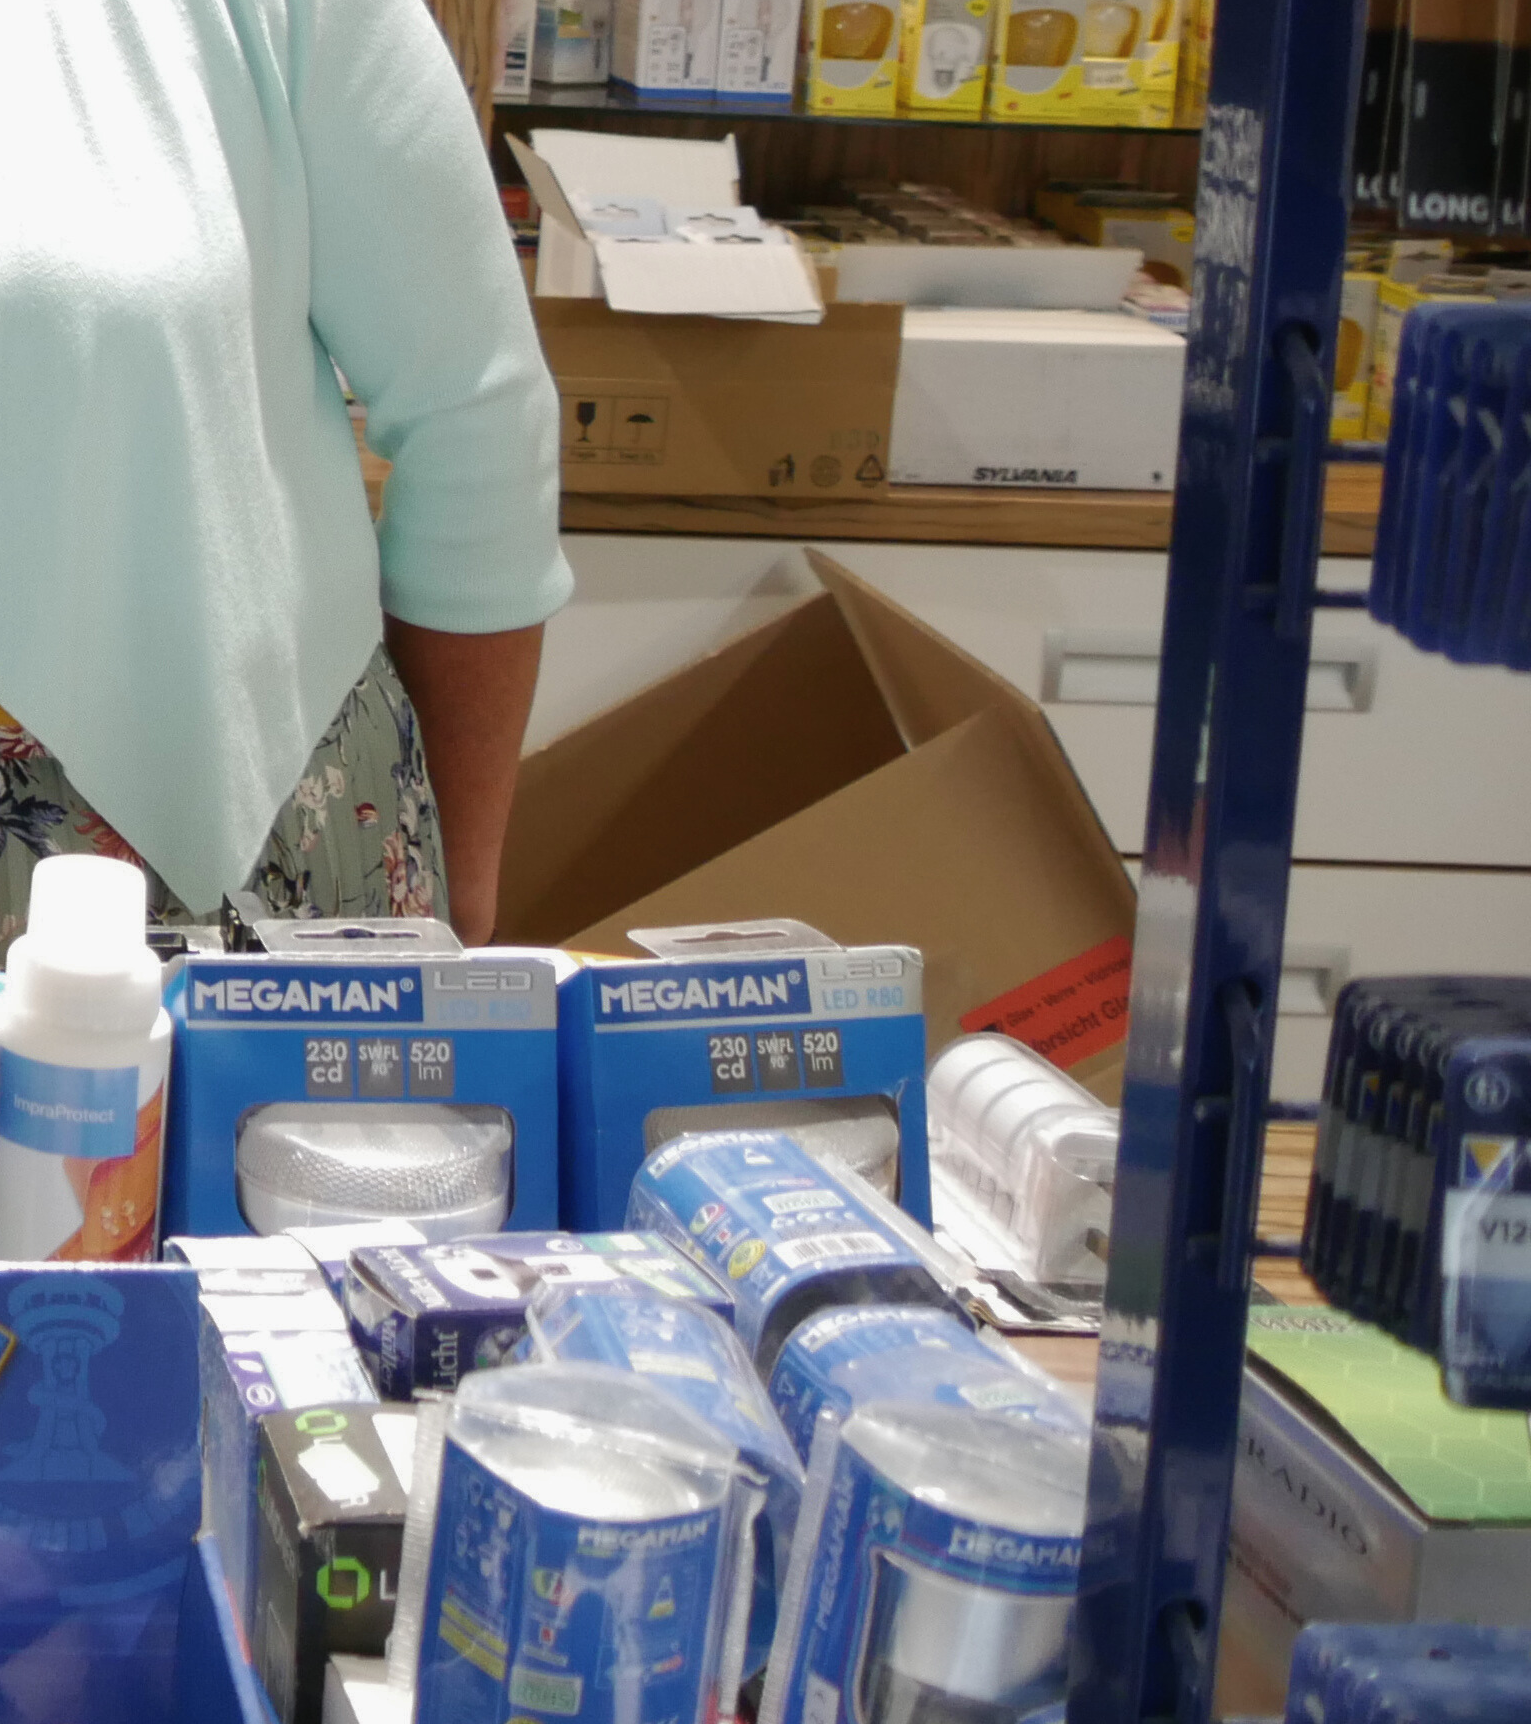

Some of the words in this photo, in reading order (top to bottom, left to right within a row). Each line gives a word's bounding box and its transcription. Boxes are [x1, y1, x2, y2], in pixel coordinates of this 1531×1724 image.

[1409, 194, 1489, 222] LONG
[975, 467, 1077, 483] SYLVANIA
[434, 971, 532, 991] LED
[821, 958, 905, 980] LED
[823, 988, 858, 1010] LED
[866, 986, 904, 1008] R80
[709, 1038, 747, 1060] 230
[756, 1036, 794, 1056] SWFL
[803, 1033, 838, 1053] 520
[1031, 1012, 1101, 1056] orsicht
[306, 1042, 347, 1062] 230
[358, 1043, 399, 1061] SWFL
[409, 1042, 450, 1062] 520
[312, 1062, 343, 1083] cd
[418, 1063, 442, 1080] lm
[716, 1058, 746, 1080] cd
[811, 1052, 833, 1071] lm
[13, 1094, 115, 1126] ImpraProtect
[648, 1129, 779, 1178] MEGAMAN
[1247, 1439, 1369, 1557] RADIO
[577, 1519, 707, 1546] MEGAMAN
